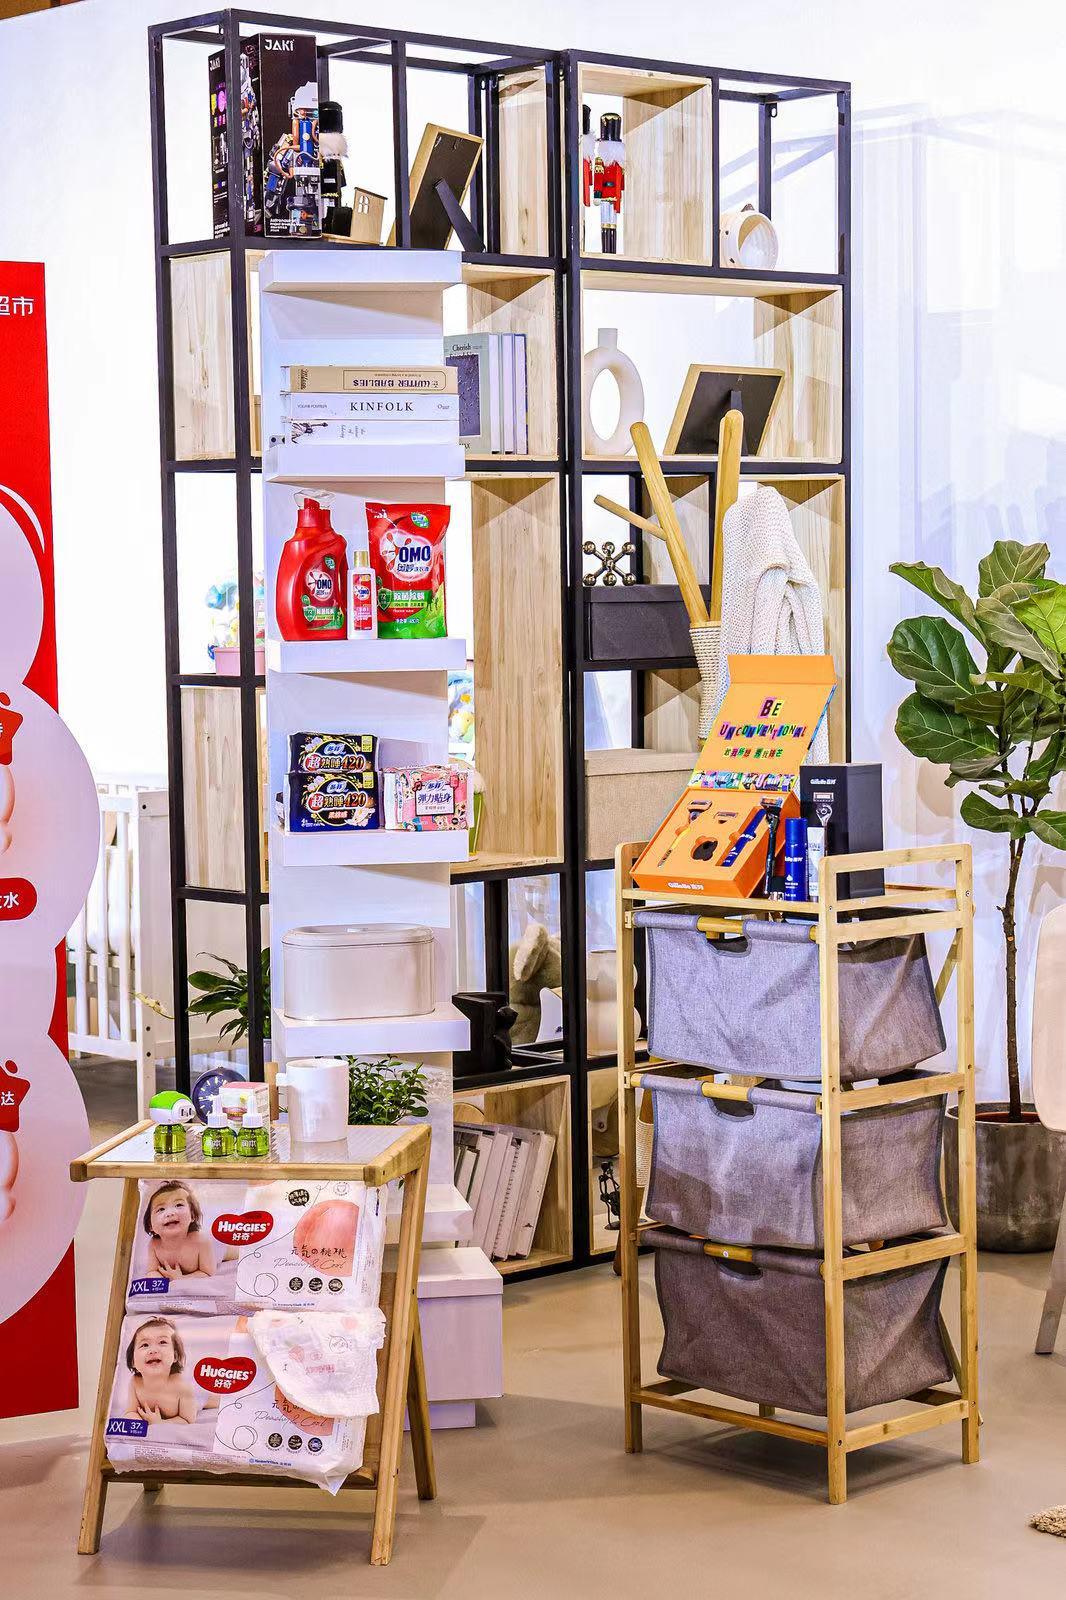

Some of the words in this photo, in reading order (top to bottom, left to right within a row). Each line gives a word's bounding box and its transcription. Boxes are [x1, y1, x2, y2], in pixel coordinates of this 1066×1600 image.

[350, 401, 414, 412] KINFOLK
[399, 545, 431, 562] OMO
[316, 579, 332, 589] OMO
[760, 699, 782, 717] BE
[719, 722, 807, 741] UNCONVENTIONAL
[0, 891, 19, 909] 水
[218, 1220, 267, 1232] HUGGIES
[232, 1232, 250, 1241] 好奇
[131, 1280, 150, 1293] XXL
[200, 1364, 250, 1381] HUGGIES
[214, 1379, 232, 1389] 好奇
[109, 1420, 128, 1433] XXL
